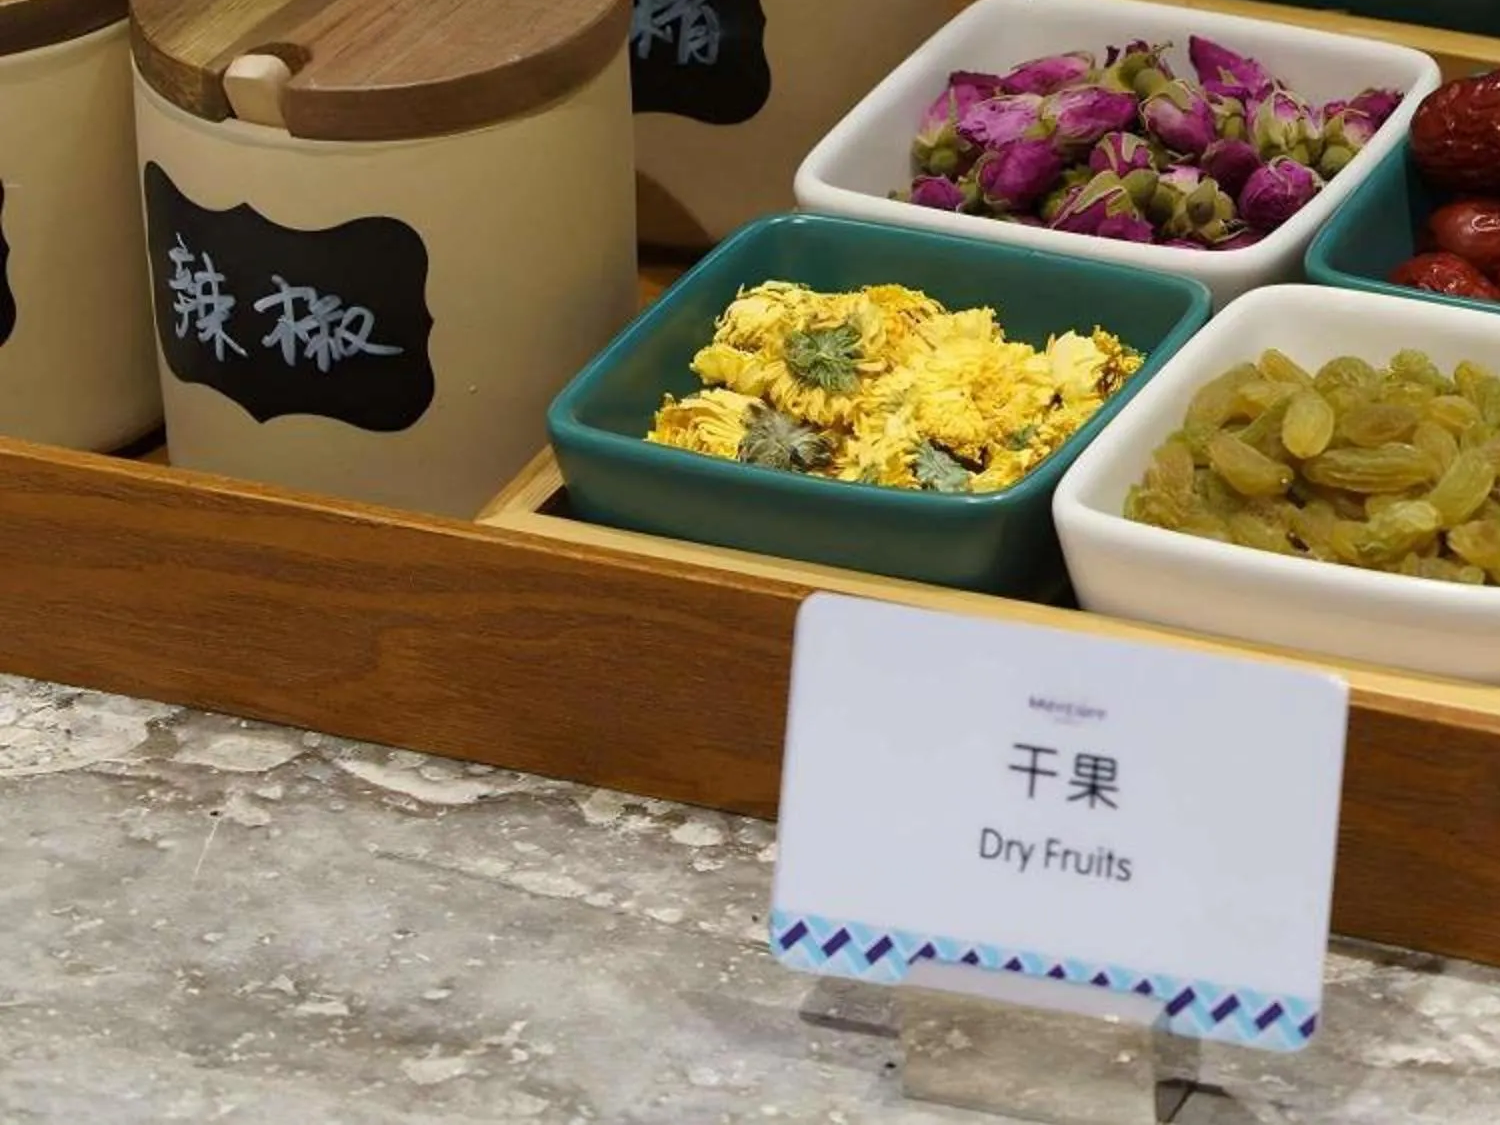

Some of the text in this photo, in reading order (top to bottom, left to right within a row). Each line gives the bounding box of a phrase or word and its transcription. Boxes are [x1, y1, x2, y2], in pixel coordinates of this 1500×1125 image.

[168, 232, 405, 373] 辣椒
[1007, 743, 1119, 810] 干果
[979, 827, 1132, 883] Dry Fruits
